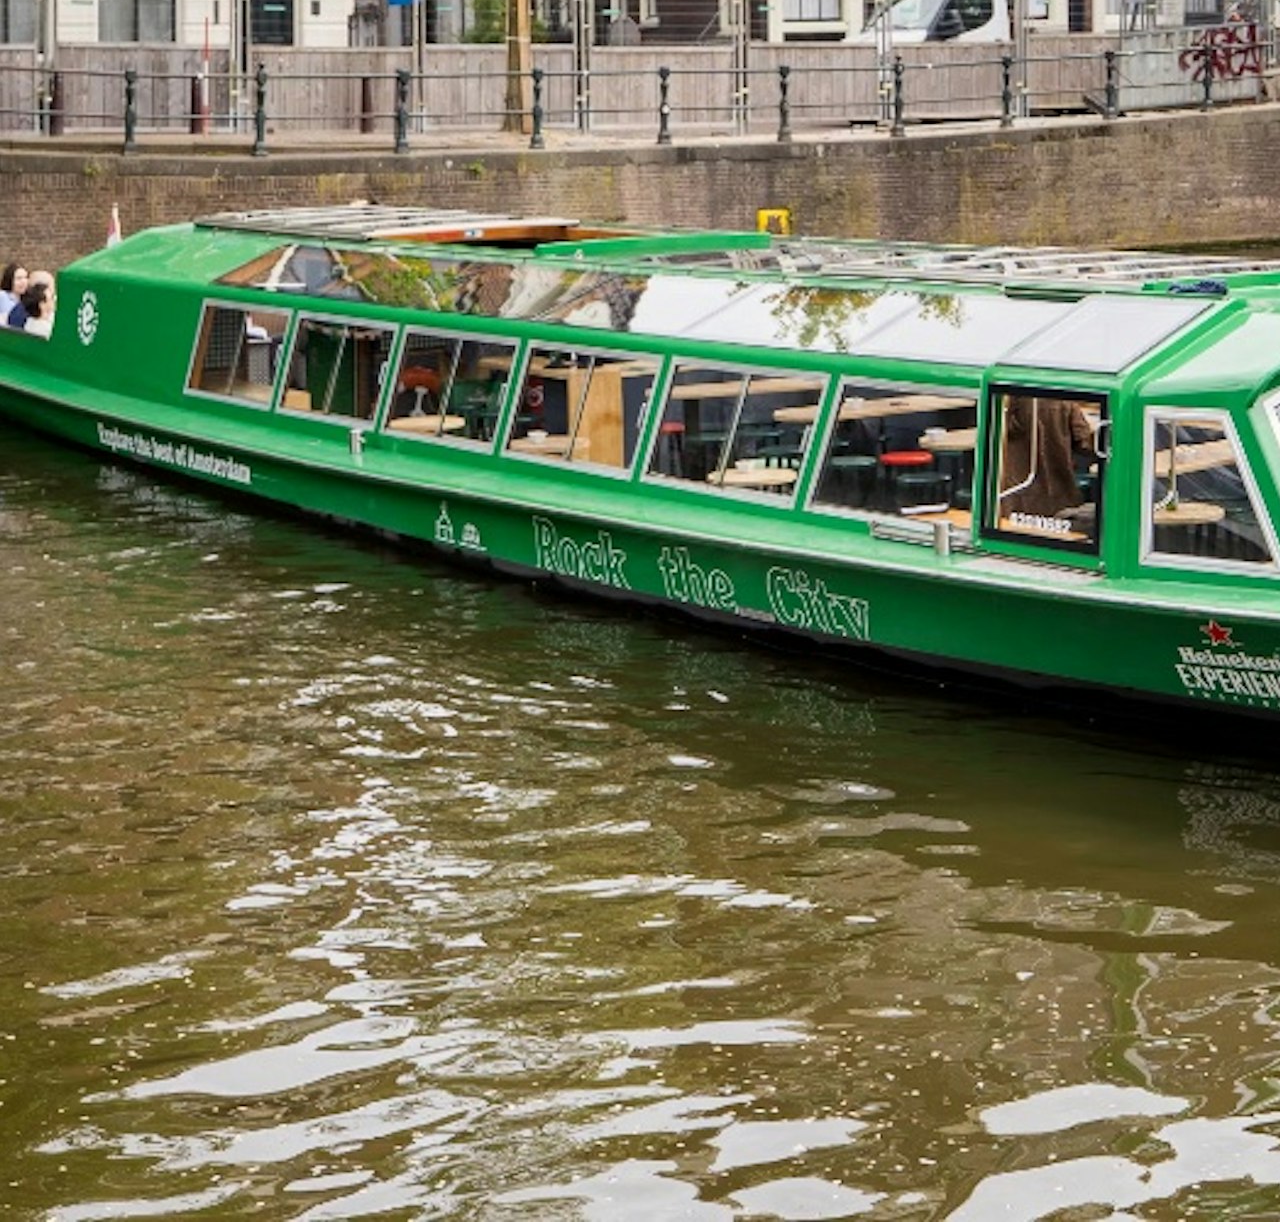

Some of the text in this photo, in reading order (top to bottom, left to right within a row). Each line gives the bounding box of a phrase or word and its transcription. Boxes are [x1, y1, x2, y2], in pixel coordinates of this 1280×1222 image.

[135, 433, 152, 458] the
[151, 437, 174, 464] best
[175, 444, 188, 467] of
[188, 446, 251, 484] Amsterdam
[533, 515, 871, 641] Rock the City
